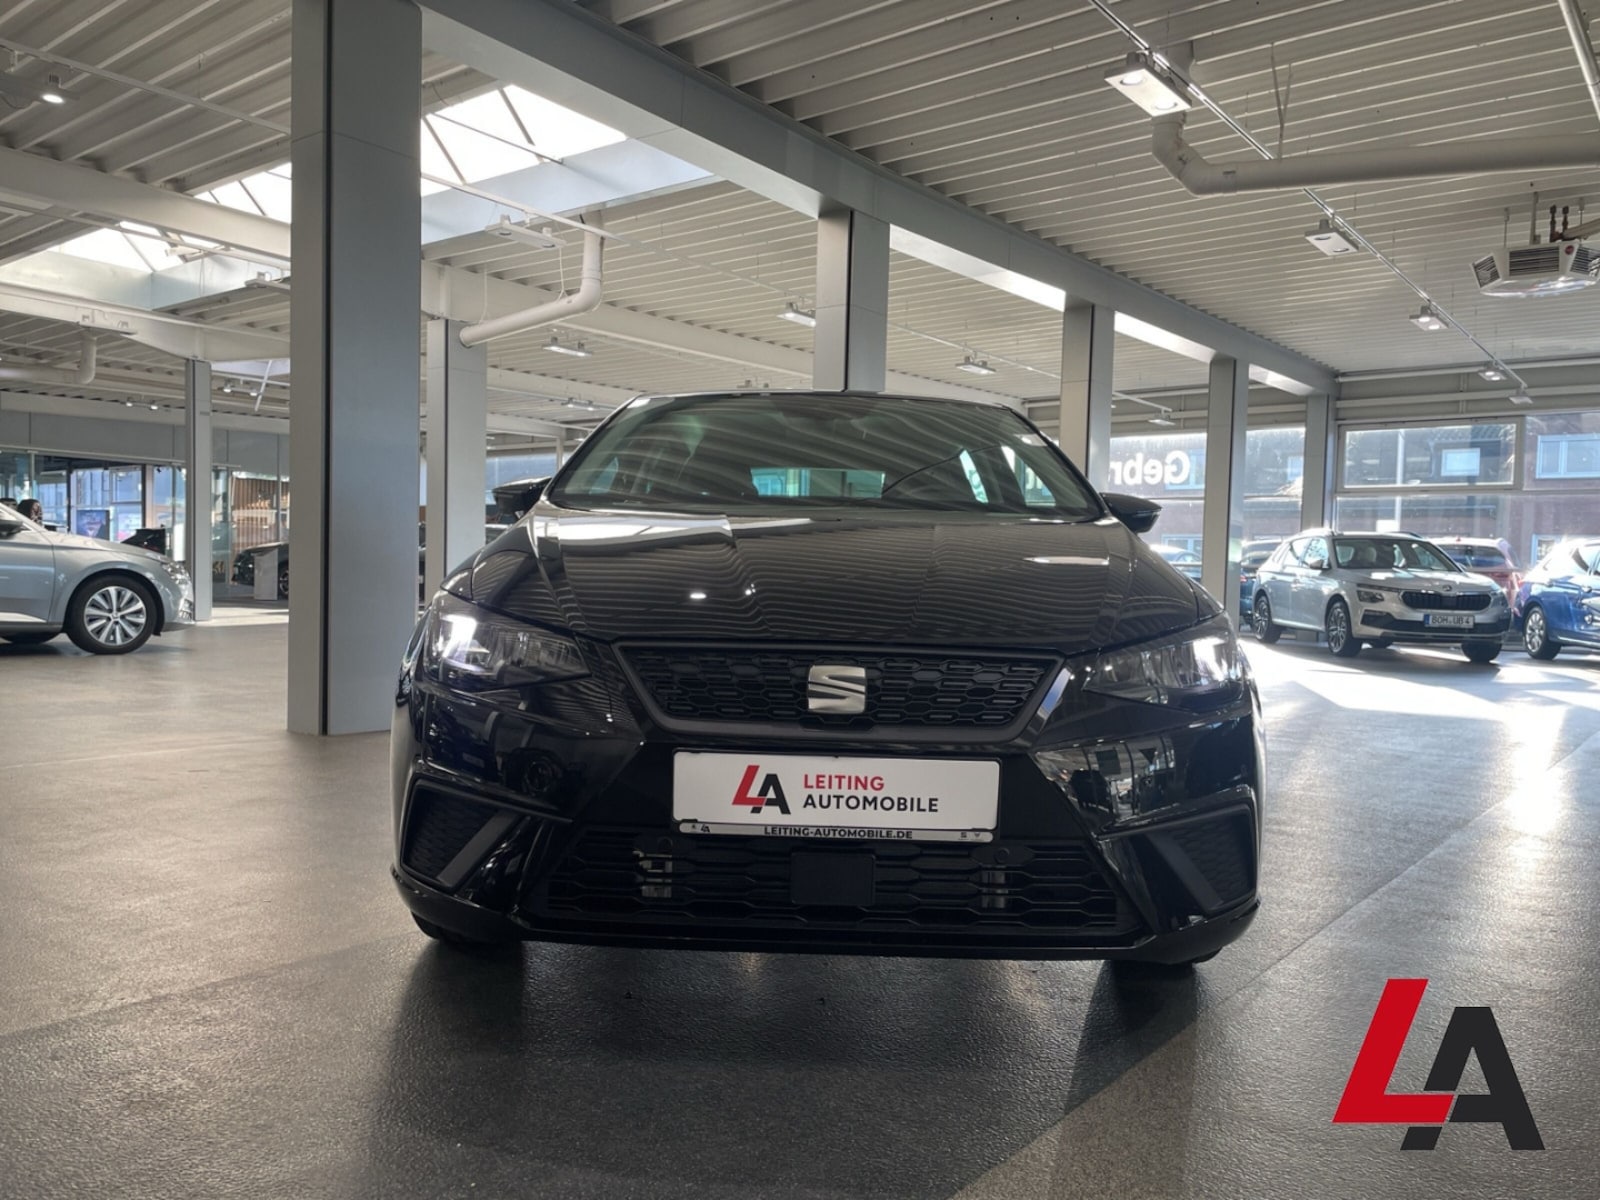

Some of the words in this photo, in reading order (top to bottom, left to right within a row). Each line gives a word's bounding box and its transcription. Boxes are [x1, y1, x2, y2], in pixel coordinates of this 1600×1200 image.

[731, 764, 791, 815] LA
[803, 774, 885, 791] LEITING
[803, 794, 939, 813] AUTOMOBILE
[764, 826, 912, 839] LEITING-AUTOMOBILE.DE
